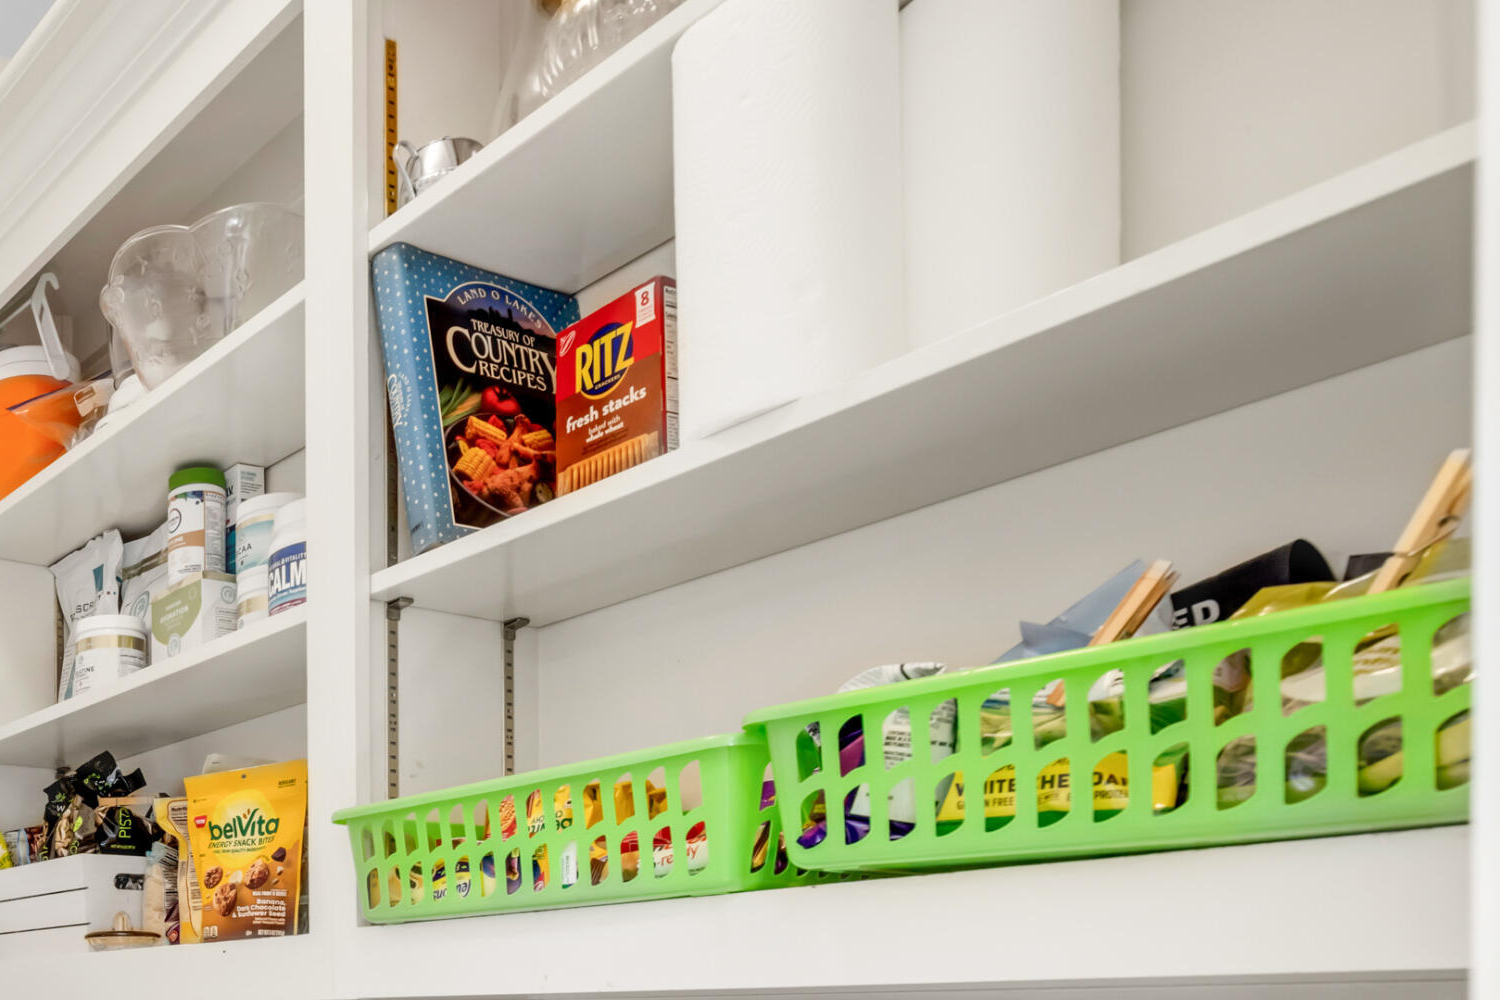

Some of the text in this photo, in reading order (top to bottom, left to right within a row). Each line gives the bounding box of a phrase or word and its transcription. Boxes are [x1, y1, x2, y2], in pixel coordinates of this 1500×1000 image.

[457, 288, 543, 329] LAND O LAKES
[641, 291, 649, 306] 8
[470, 318, 536, 347] TREASURY OF
[446, 325, 557, 394] COUNTRY
[575, 320, 635, 394] RITZ
[479, 360, 548, 392] RECIPES
[566, 386, 648, 434] fresh stacks
[588, 415, 621, 436] baked with
[268, 560, 307, 599] CALM
[208, 808, 280, 841] belVita
[208, 841, 232, 849] ENERGY
[233, 839, 257, 847] SNACK
[256, 898, 286, 906] Banana,
